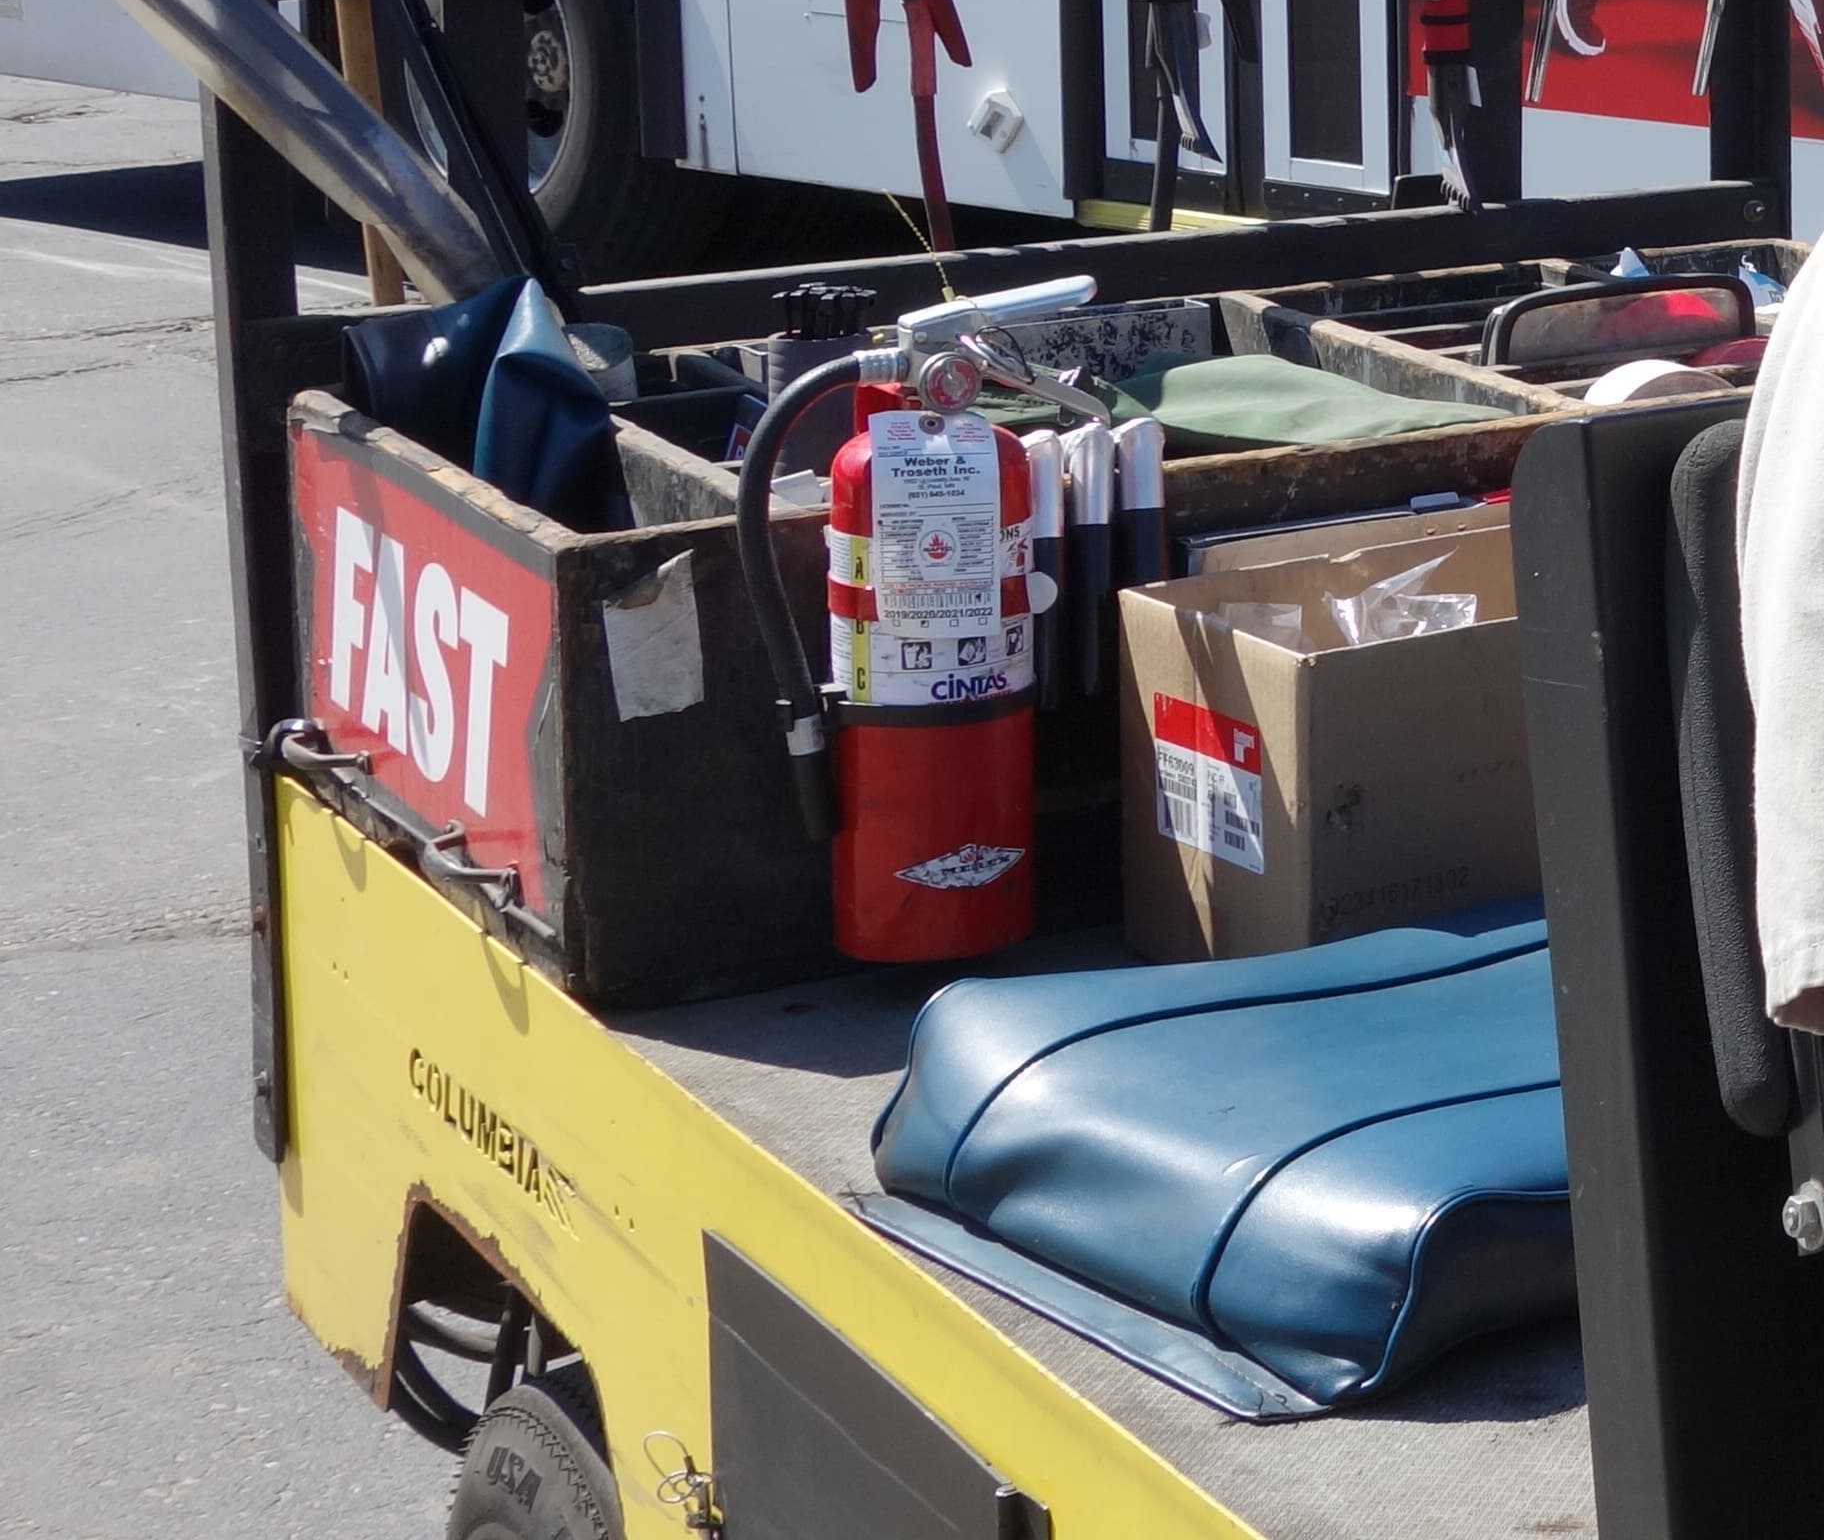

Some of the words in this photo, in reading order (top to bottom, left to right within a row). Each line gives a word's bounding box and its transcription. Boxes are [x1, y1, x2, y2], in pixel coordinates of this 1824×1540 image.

[891, 465, 947, 478] Troseth
[953, 465, 981, 476] Inc.
[904, 457, 951, 467] Weber
[956, 455, 966, 465] &
[855, 557, 865, 580] A
[329, 505, 510, 819] FAST
[856, 667, 866, 691] C
[409, 1047, 542, 1203] COLUMBIA
[486, 1445, 544, 1515] USA
